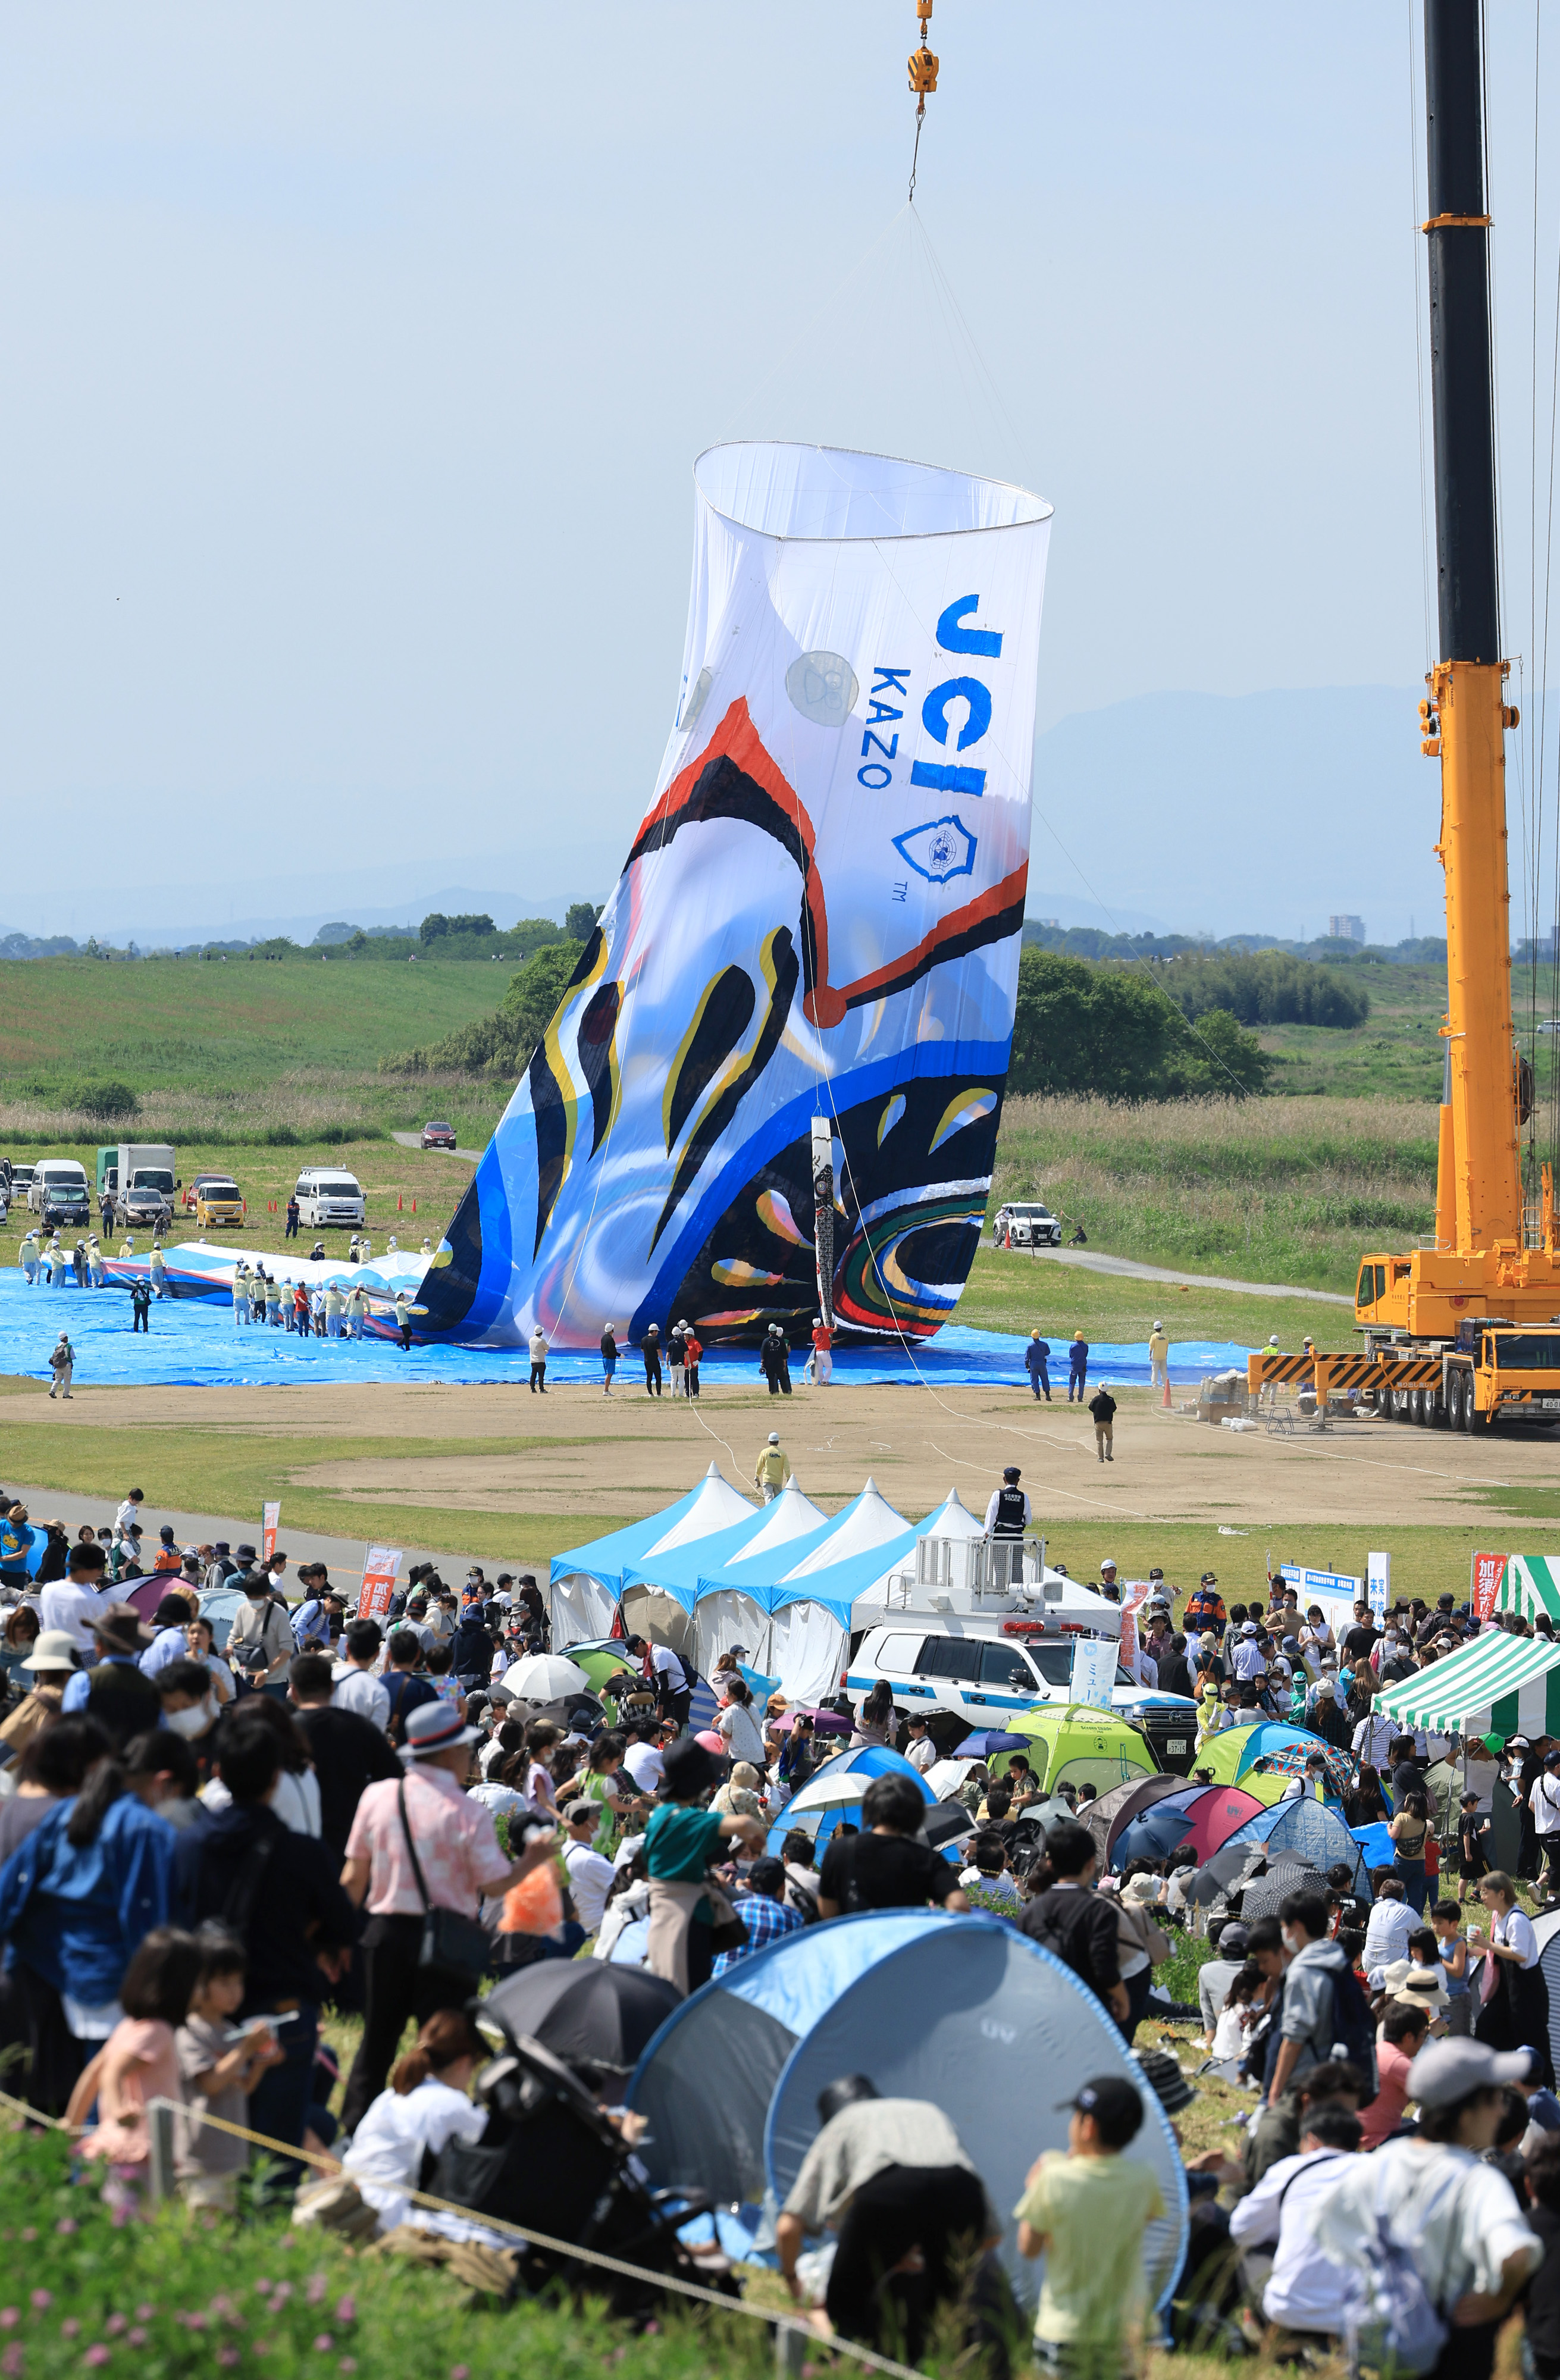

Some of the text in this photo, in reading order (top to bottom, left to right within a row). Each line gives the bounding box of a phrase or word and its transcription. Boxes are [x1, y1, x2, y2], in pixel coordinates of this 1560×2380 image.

[910, 594, 1003, 797] JCI
[857, 667, 911, 790] KAZO
[892, 881, 908, 903] TM
[1478, 1559, 1495, 1618] 加須市
[1087, 1662, 1097, 1706] ミュー
